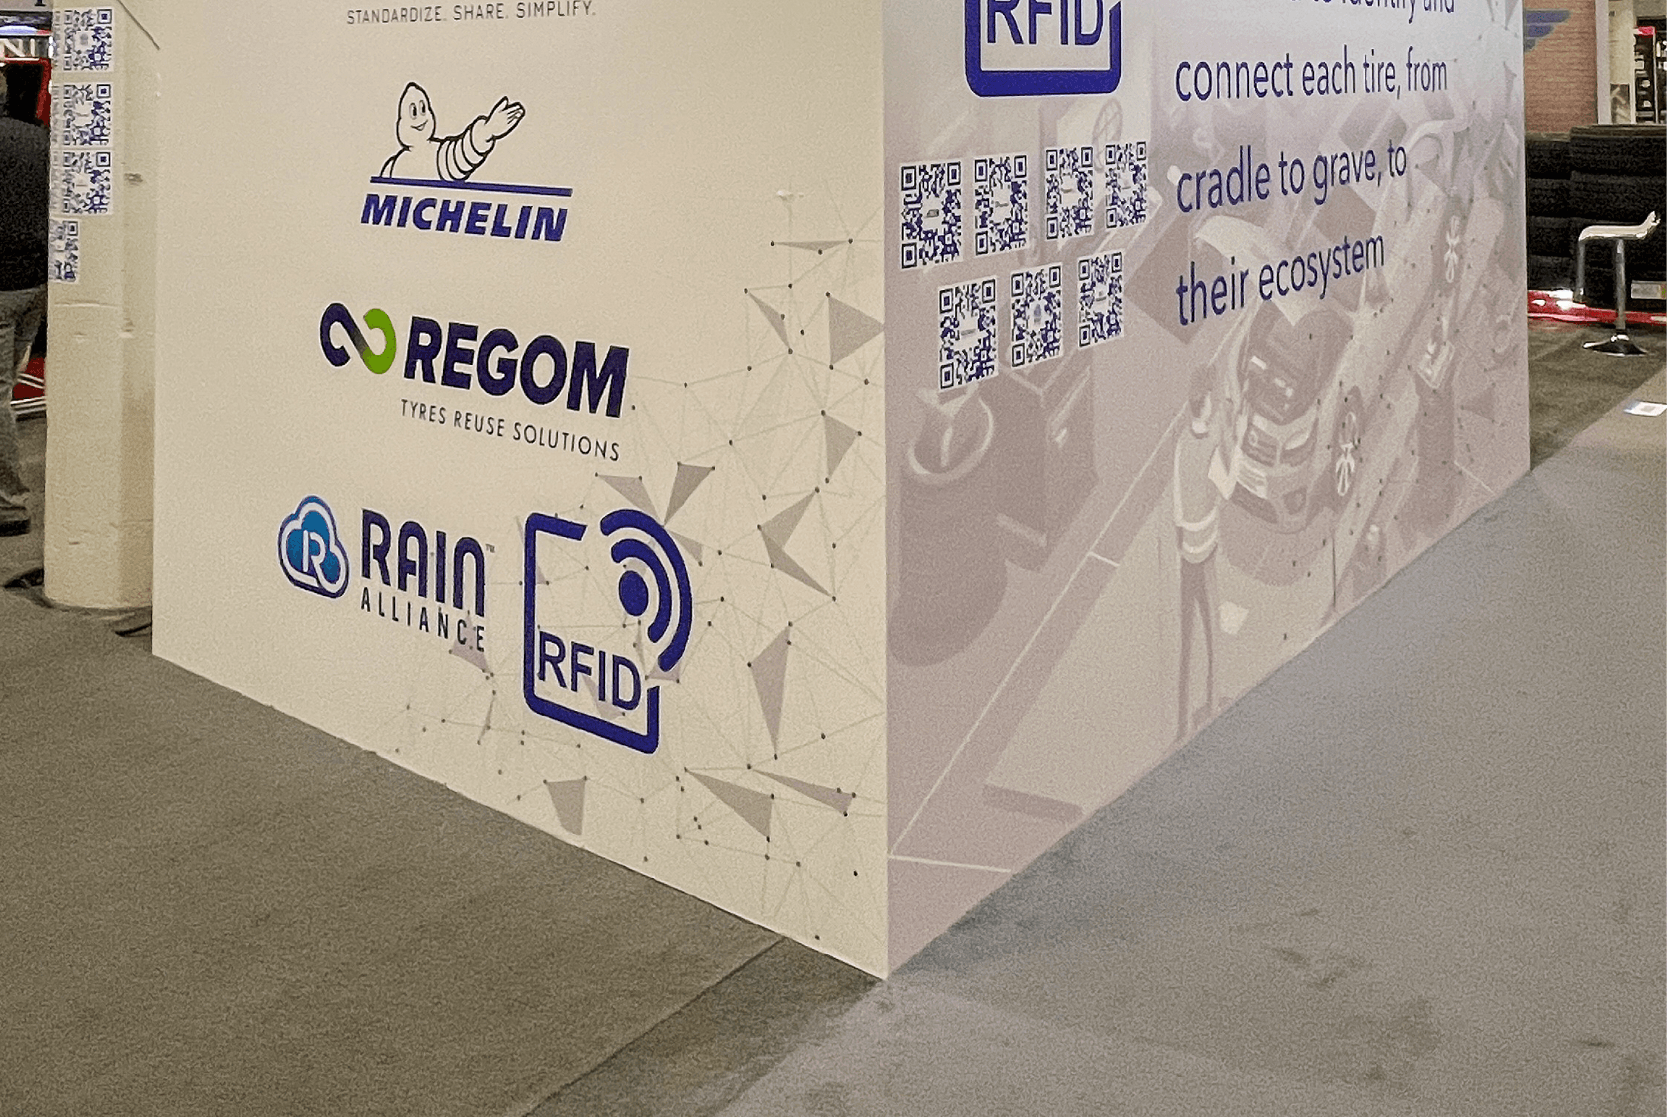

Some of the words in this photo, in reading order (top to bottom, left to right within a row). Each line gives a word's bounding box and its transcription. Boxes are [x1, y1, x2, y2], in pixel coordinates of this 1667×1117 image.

[346, 5, 447, 24] STANDARDIZE.
[453, 2, 510, 21] SHARE.
[516, 0, 597, 19] SIMPLIFY.
[1175, 53, 1293, 101] connect
[1302, 44, 1356, 96] each
[1362, 48, 1401, 100] tire,
[1406, 46, 1448, 92] from
[1176, 145, 1271, 213] cradle
[1278, 151, 1305, 196] to
[1313, 148, 1383, 205] grave,
[1387, 139, 1407, 178] to
[360, 193, 568, 242] MICHELIN
[1175, 253, 1249, 326] their
[1258, 235, 1385, 300] ecosystem
[403, 316, 630, 419] REGOM
[401, 399, 447, 425] TYRES
[453, 410, 505, 437] REUSE
[513, 421, 620, 462] SOLUTIONS
[361, 508, 485, 618] RAIN
[360, 586, 486, 653] ALLIANCE
[537, 630, 642, 711] RFID
